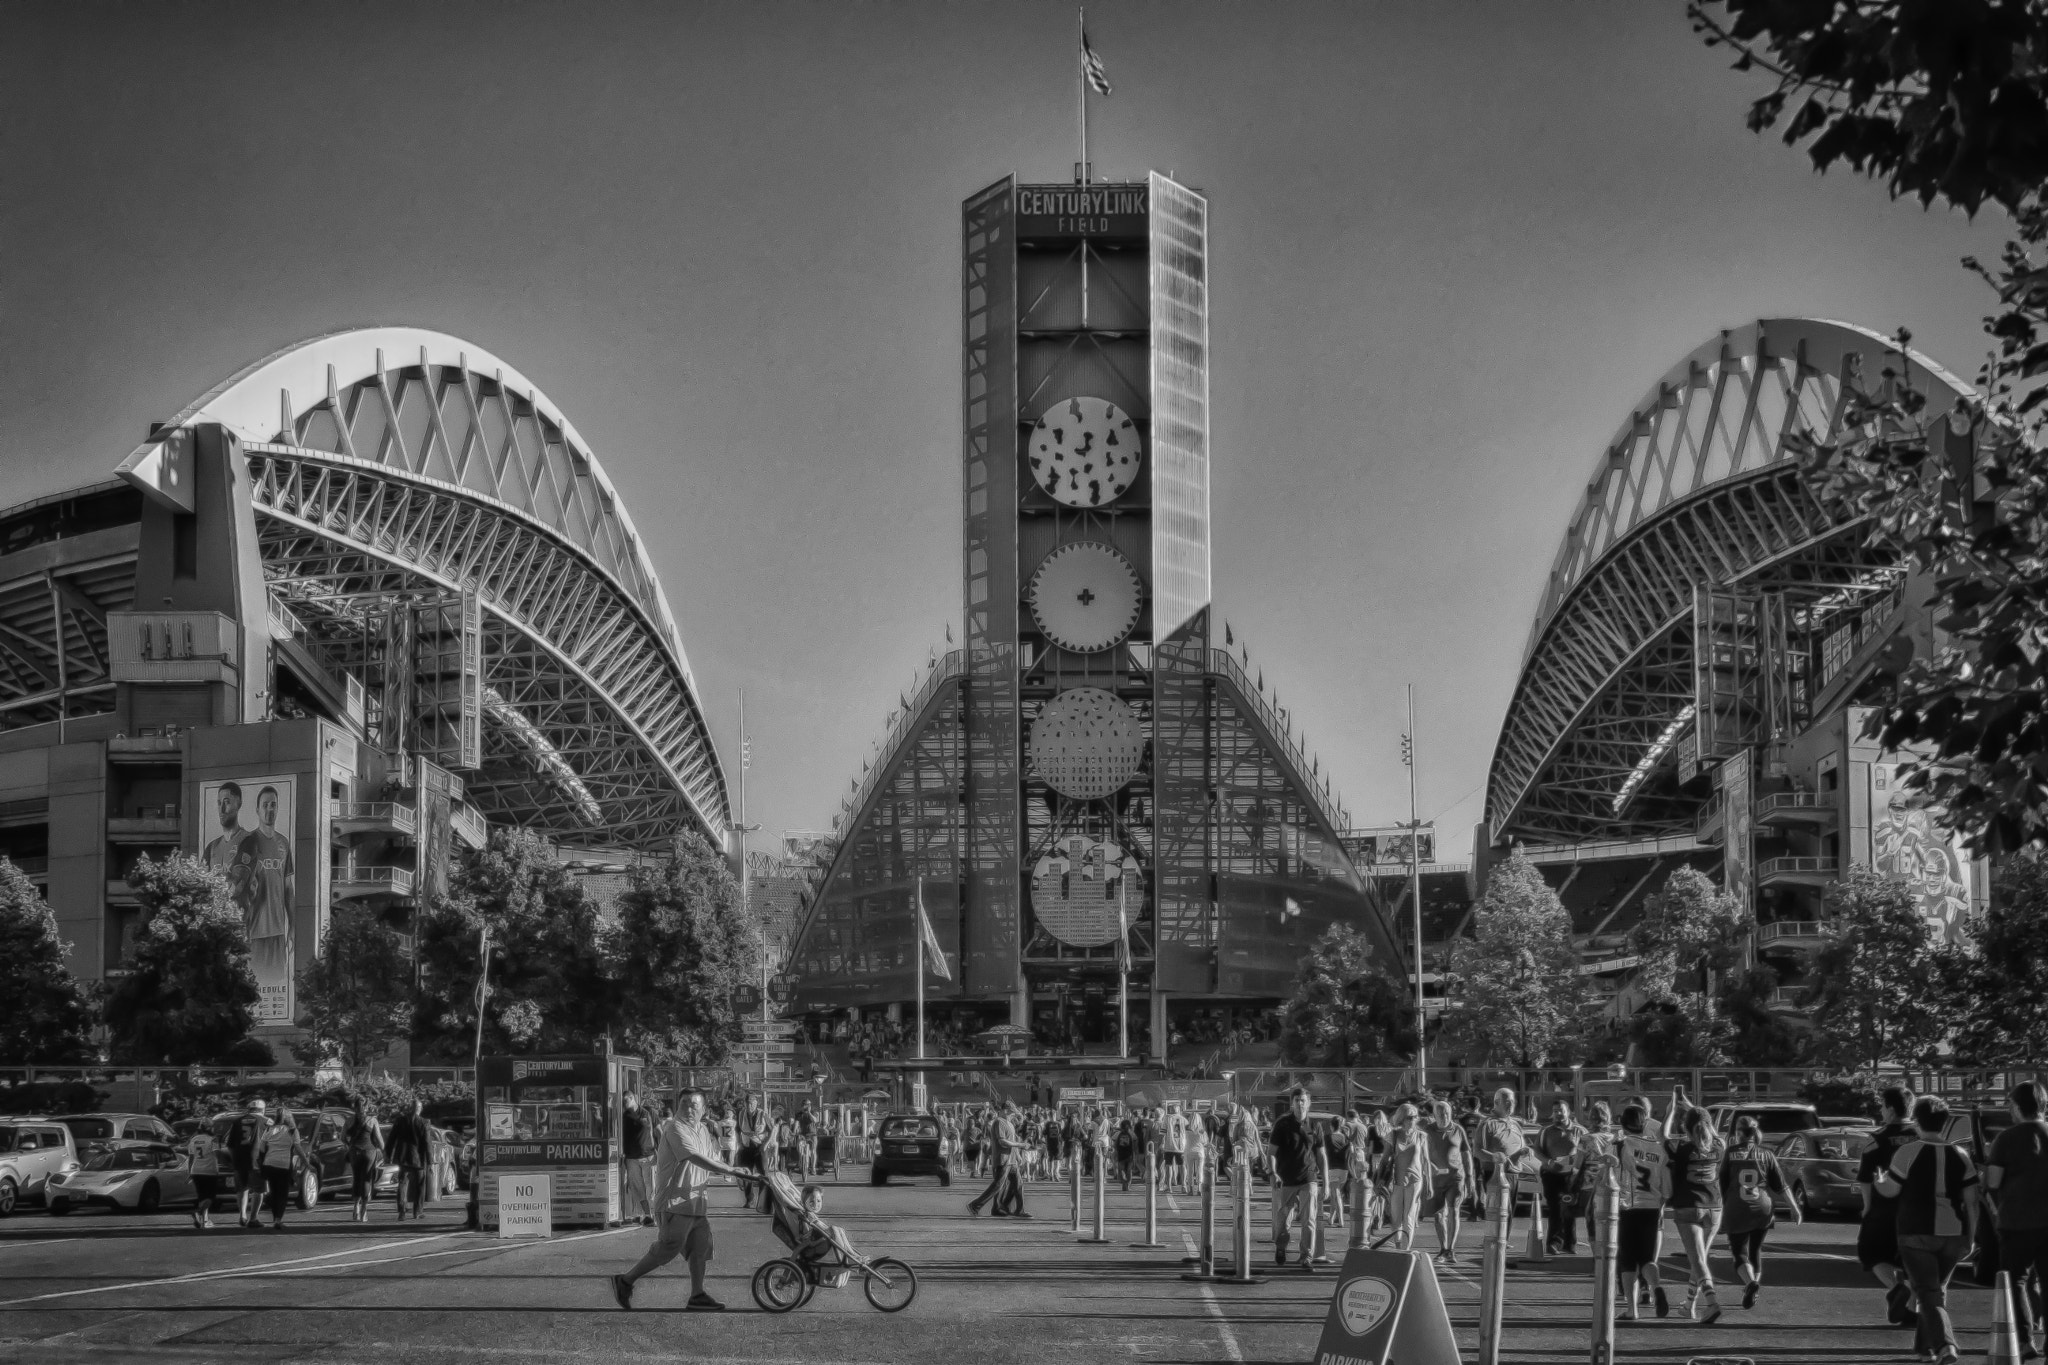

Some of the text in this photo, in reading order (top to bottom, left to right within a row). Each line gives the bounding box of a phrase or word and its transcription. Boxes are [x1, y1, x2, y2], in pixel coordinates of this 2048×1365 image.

[1020, 190, 1146, 215] CENTURYLINK
[1058, 217, 1108, 232] FIELD
[259, 985, 287, 994] HEDULE
[777, 993, 787, 1001] SW
[722, 1126, 733, 1137] 12
[497, 1144, 602, 1159] CENTURYLINK PARKING
[1633, 1148, 1660, 1164] WILSON
[1635, 1165, 1651, 1193] 3
[1738, 1168, 1760, 1201] 8
[515, 1185, 534, 1197] NO
[502, 1202, 548, 1212] OVERNIGHT
[507, 1215, 543, 1225] PARKING
